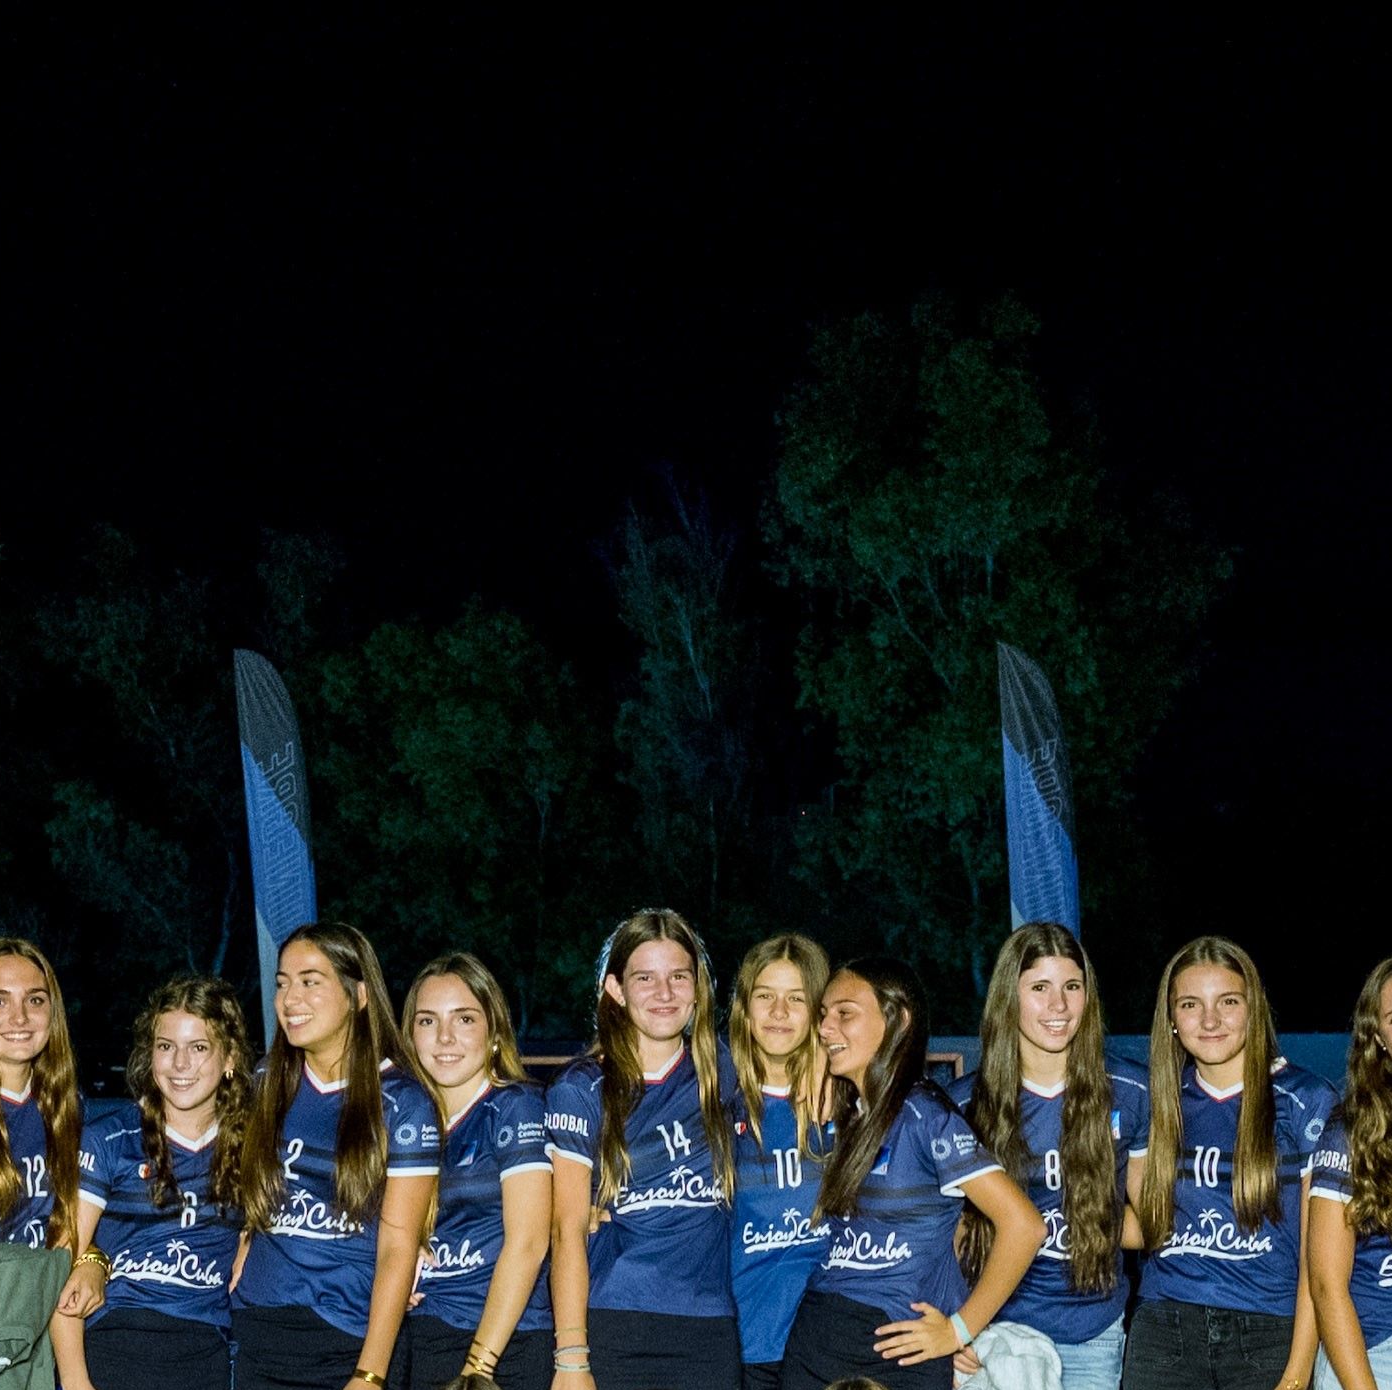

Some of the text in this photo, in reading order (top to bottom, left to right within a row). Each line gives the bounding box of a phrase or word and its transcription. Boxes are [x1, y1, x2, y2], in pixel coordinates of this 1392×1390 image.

[284, 1138, 305, 1181] 2
[657, 1120, 692, 1162] 14
[22, 1154, 48, 1199] 12
[773, 1148, 803, 1190] 10
[1045, 1149, 1062, 1191] 8
[1194, 1145, 1221, 1188] 10
[743, 1220, 795, 1247] Enjoy
[855, 1231, 912, 1263] Cuba
[1162, 1225, 1273, 1253] njoy Cuba
[111, 1249, 224, 1287] Enjoy Cuba
